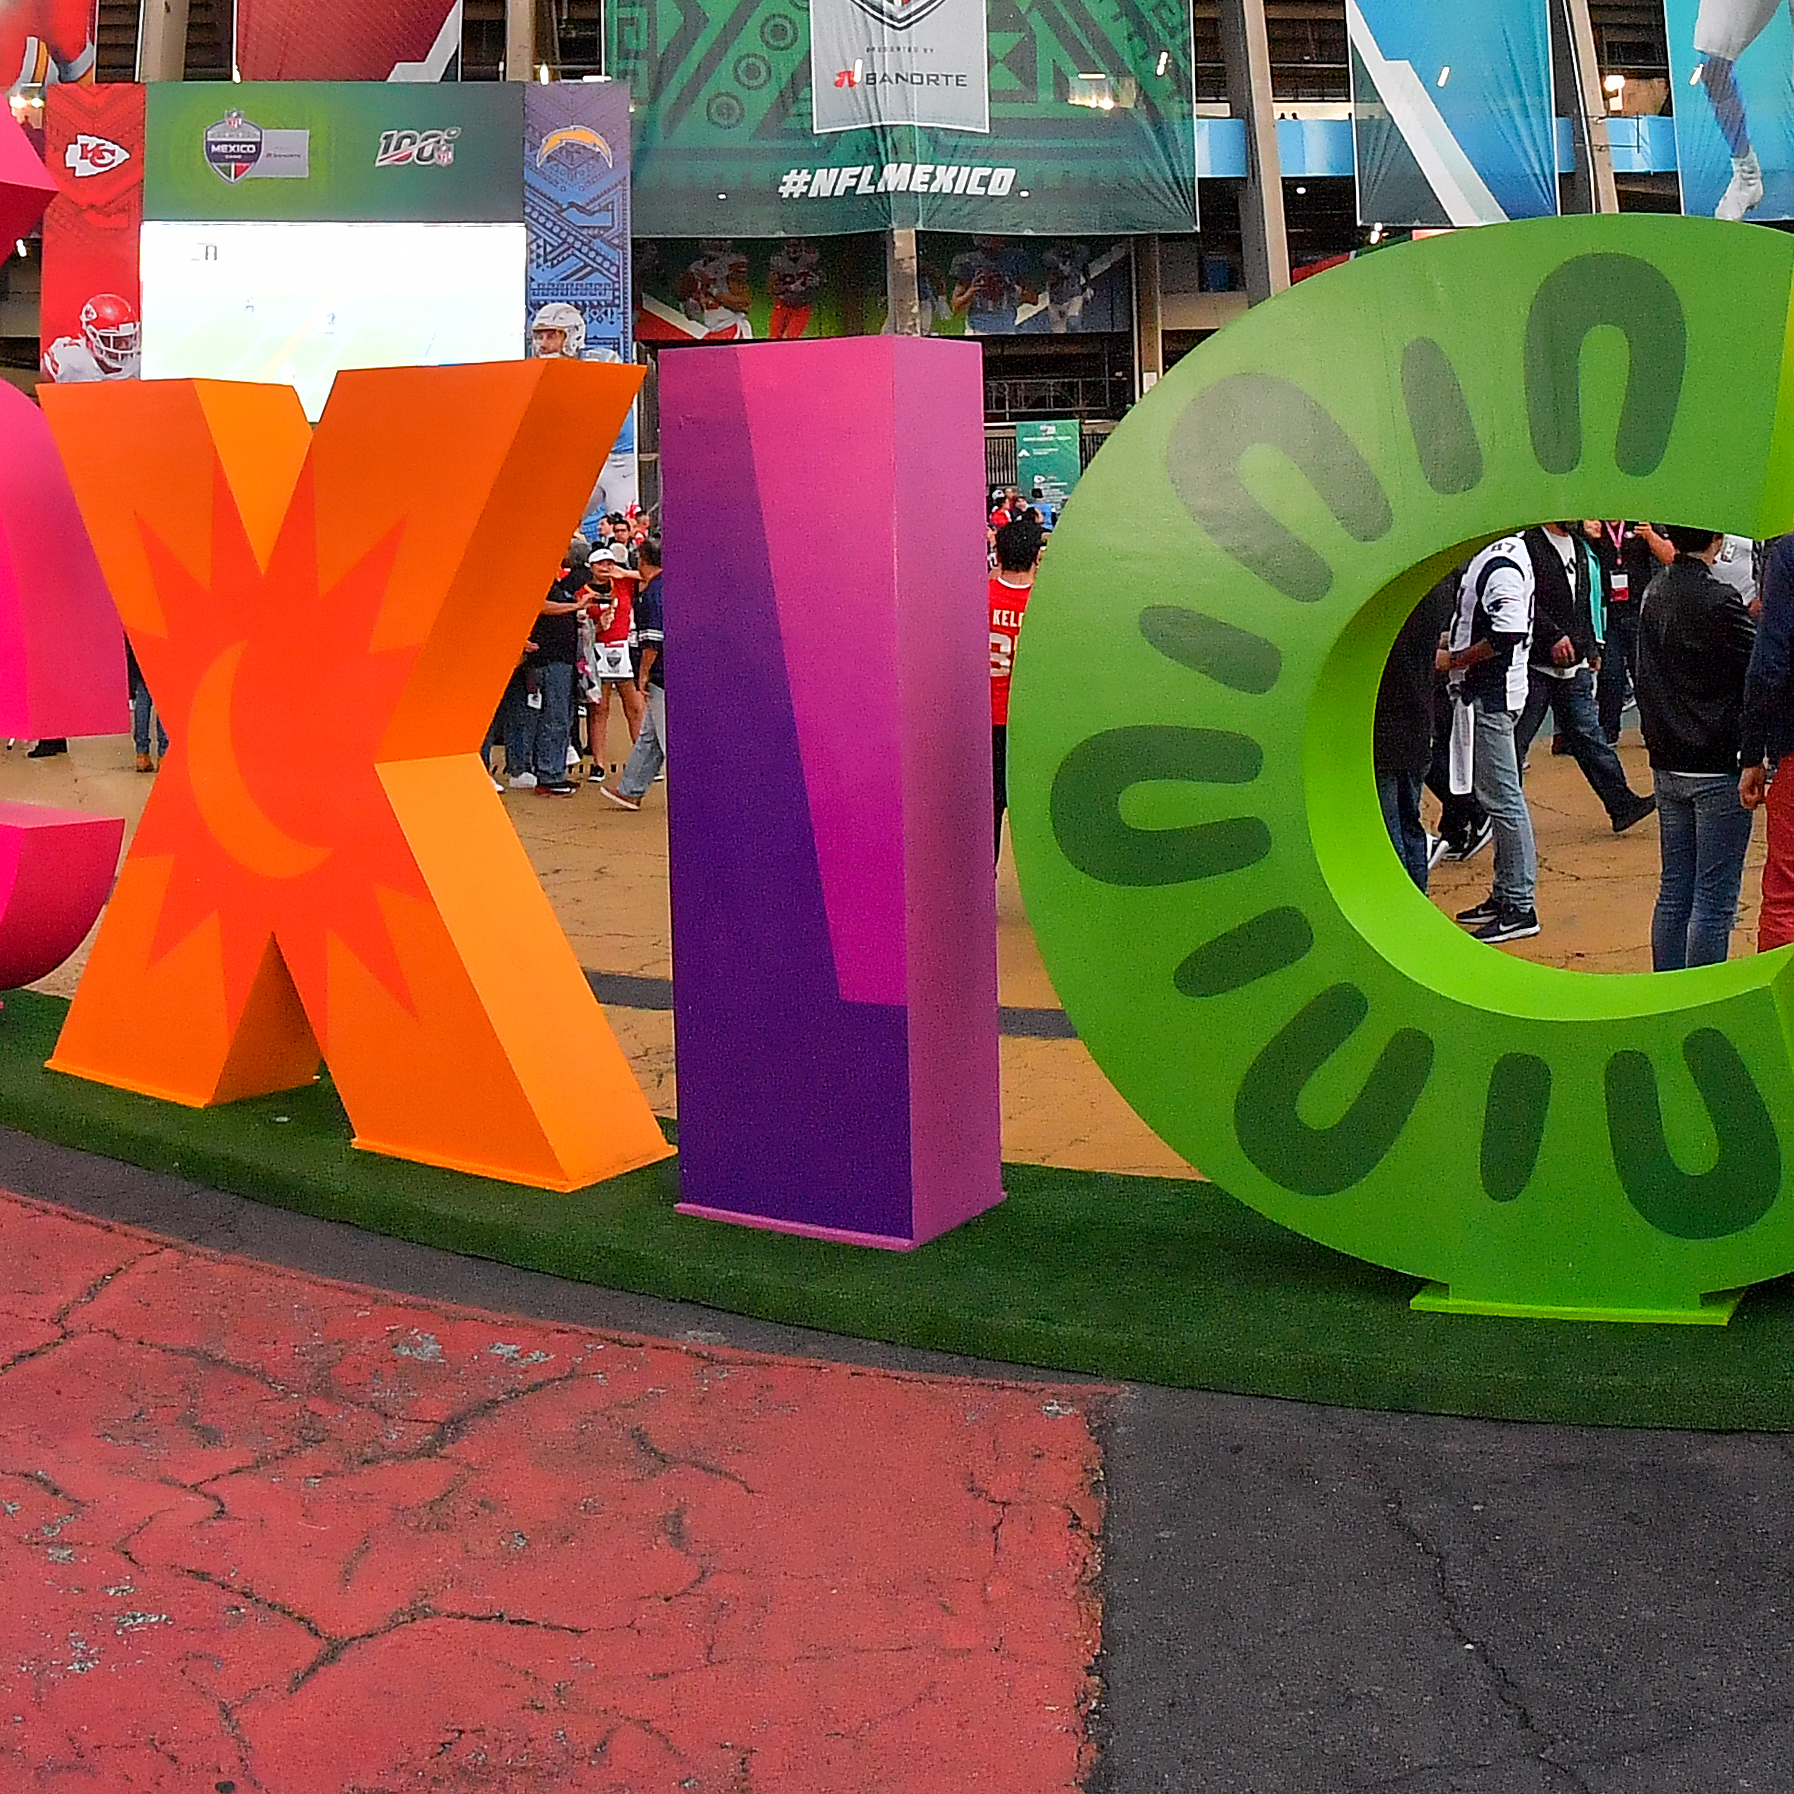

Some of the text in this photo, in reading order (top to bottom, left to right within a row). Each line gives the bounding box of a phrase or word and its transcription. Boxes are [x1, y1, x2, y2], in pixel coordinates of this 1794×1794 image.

[865, 71, 968, 87] BANORTE
[79, 143, 116, 167] KC
[211, 144, 256, 153] MEXICO
[778, 162, 1016, 198] #NFLMEXICO
